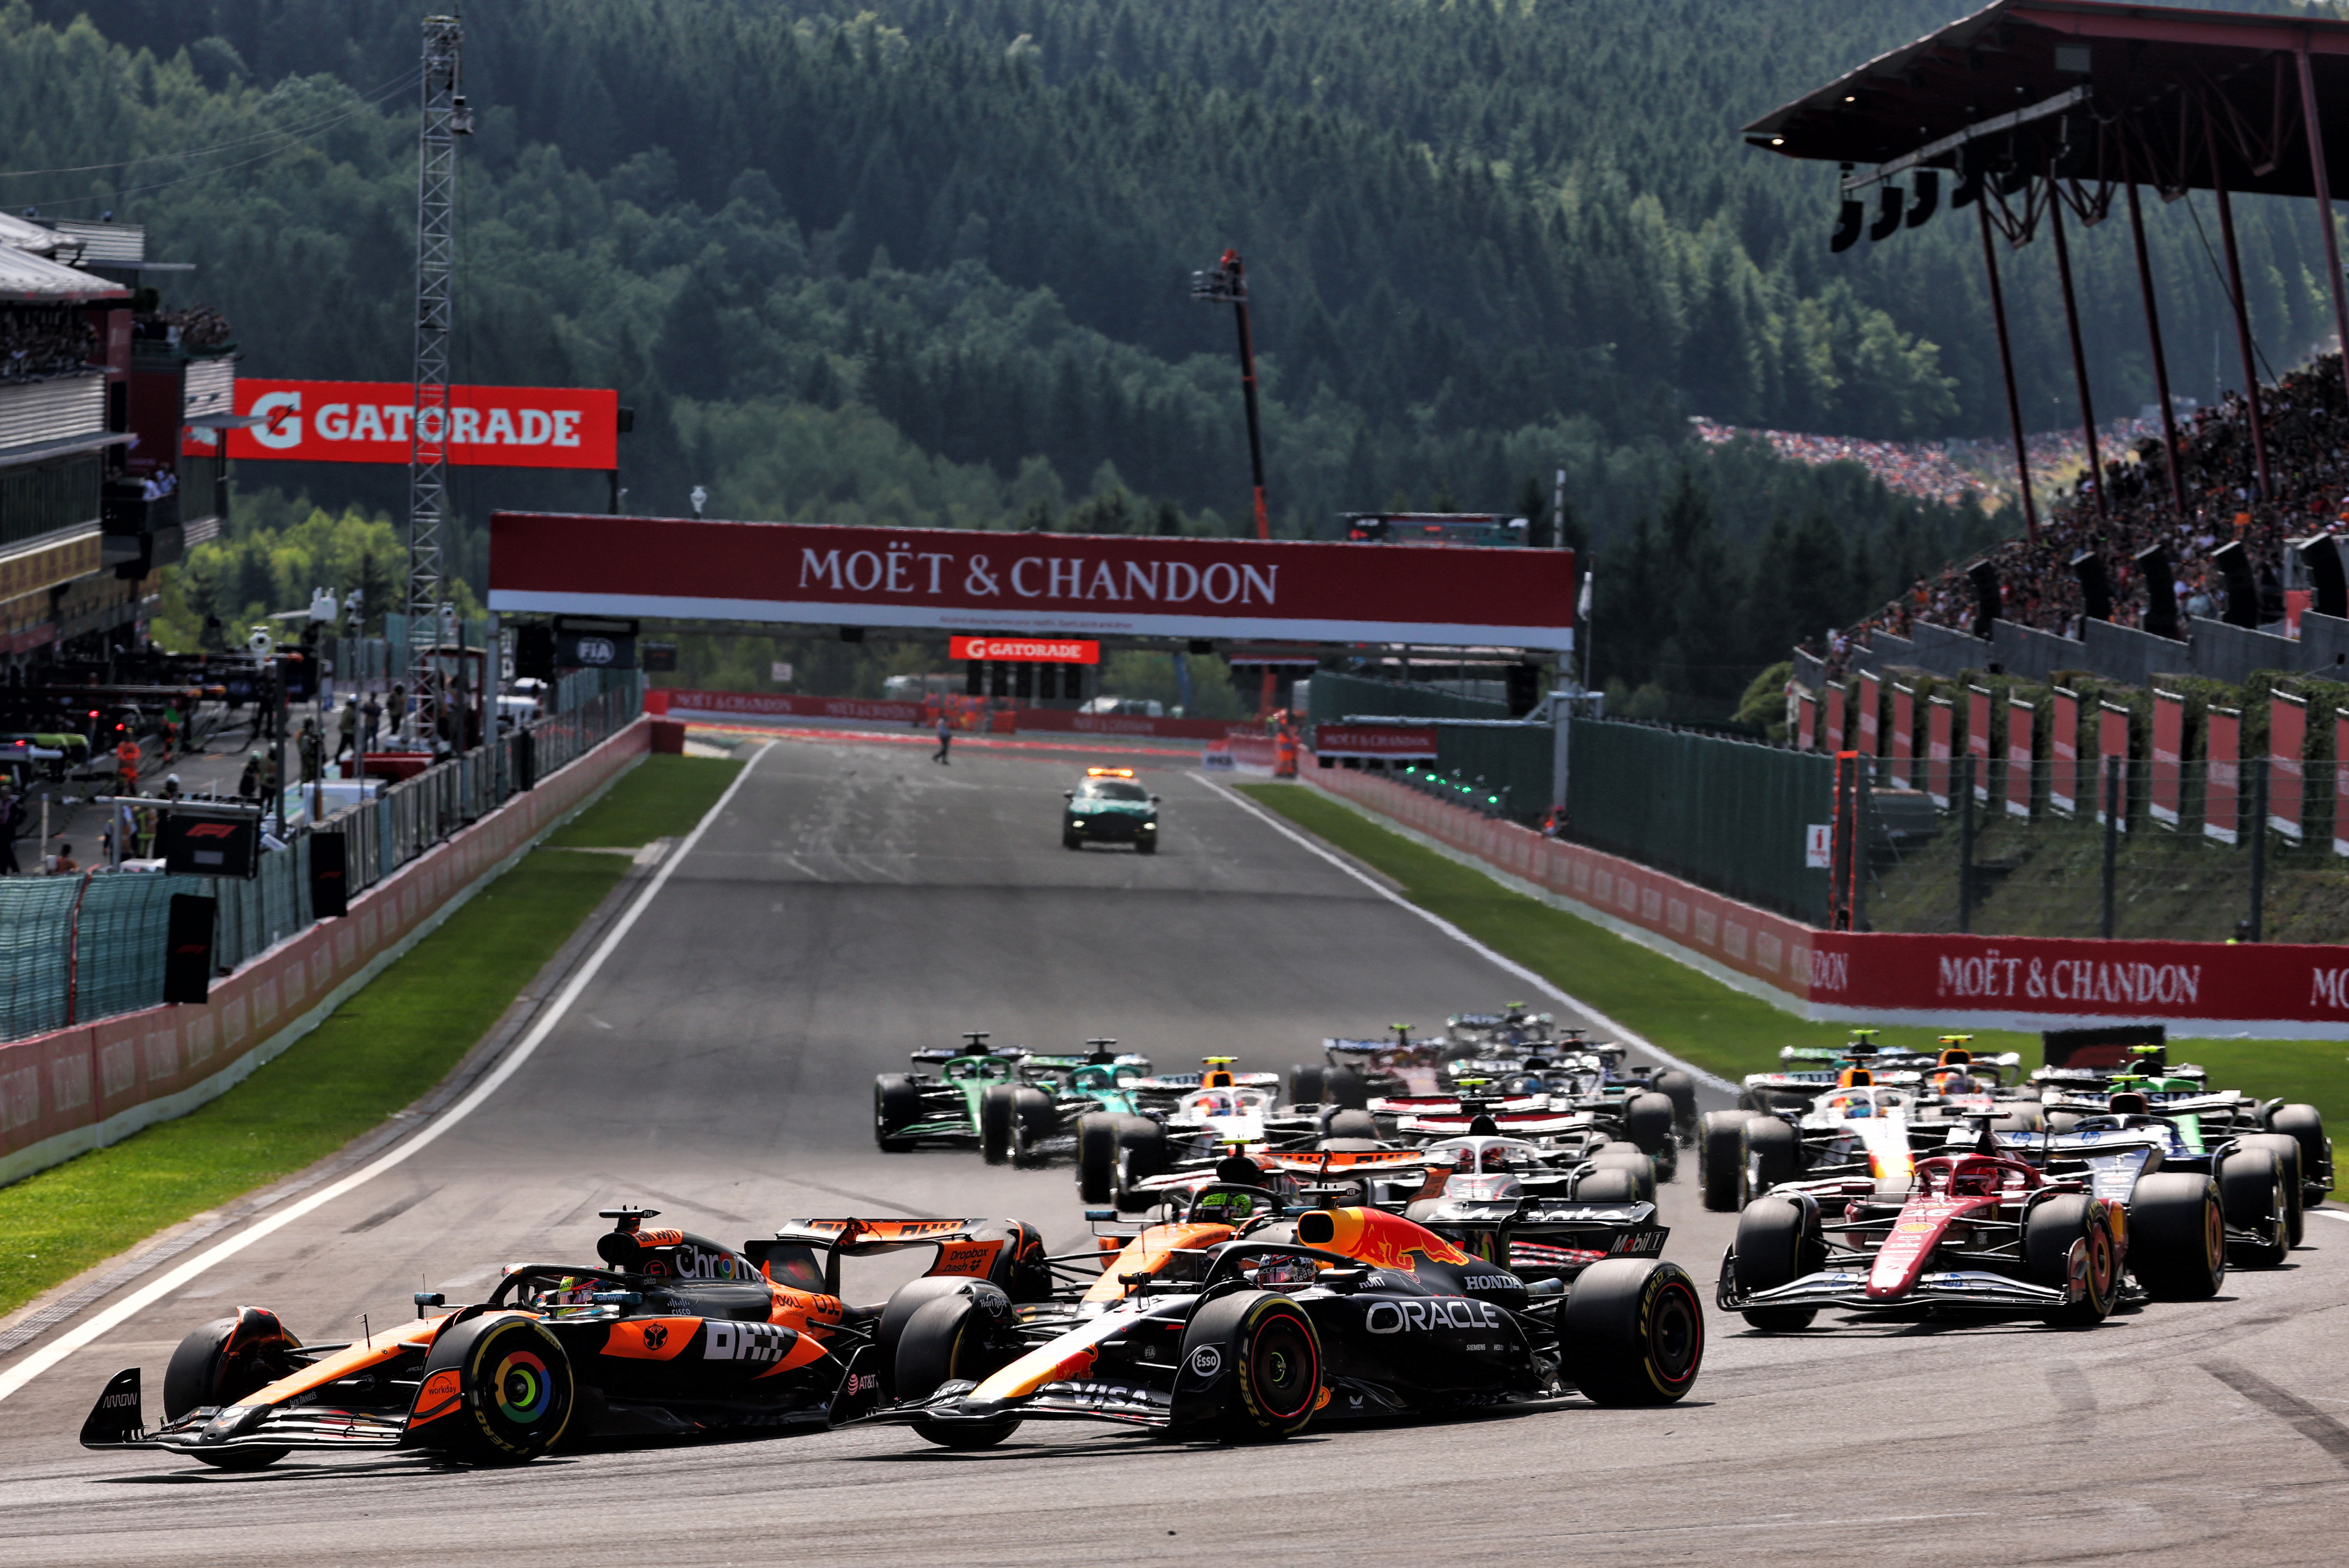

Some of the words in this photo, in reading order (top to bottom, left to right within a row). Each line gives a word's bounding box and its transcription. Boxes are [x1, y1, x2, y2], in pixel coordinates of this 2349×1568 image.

[314, 403, 581, 447] GATORADE
[799, 542, 953, 594] MOËT
[964, 554, 1000, 597] &
[1011, 557, 1279, 605] CHANDON
[578, 642, 612, 659] FIA
[989, 643, 1082, 659] GATORADE
[1938, 949, 2022, 996] MOËT
[2026, 955, 2047, 998] &
[2051, 959, 2201, 1004] CHANDON
[1903, 1208, 1952, 1217] 16
[1610, 1232, 1652, 1253] Mobil
[949, 1247, 989, 1261] Dropbox
[942, 1262, 968, 1273] Dash
[643, 1277, 656, 1285] okta
[1293, 1272, 1307, 1283] Red
[1464, 1275, 1524, 1290] HONDA
[597, 1293, 623, 1302] allwyn
[776, 1294, 804, 1309] DELL
[994, 1298, 1007, 1308] Rock
[1642, 1271, 1664, 1319] ZERO
[1365, 1301, 1500, 1334] ORACLE
[859, 1374, 876, 1390] AT&T
[1239, 1359, 1260, 1417] ZERO
[428, 1385, 456, 1396] workday
[1065, 1381, 1149, 1410] VISA
[102, 1392, 137, 1409] ARROW
[474, 1409, 516, 1452] ZERO
